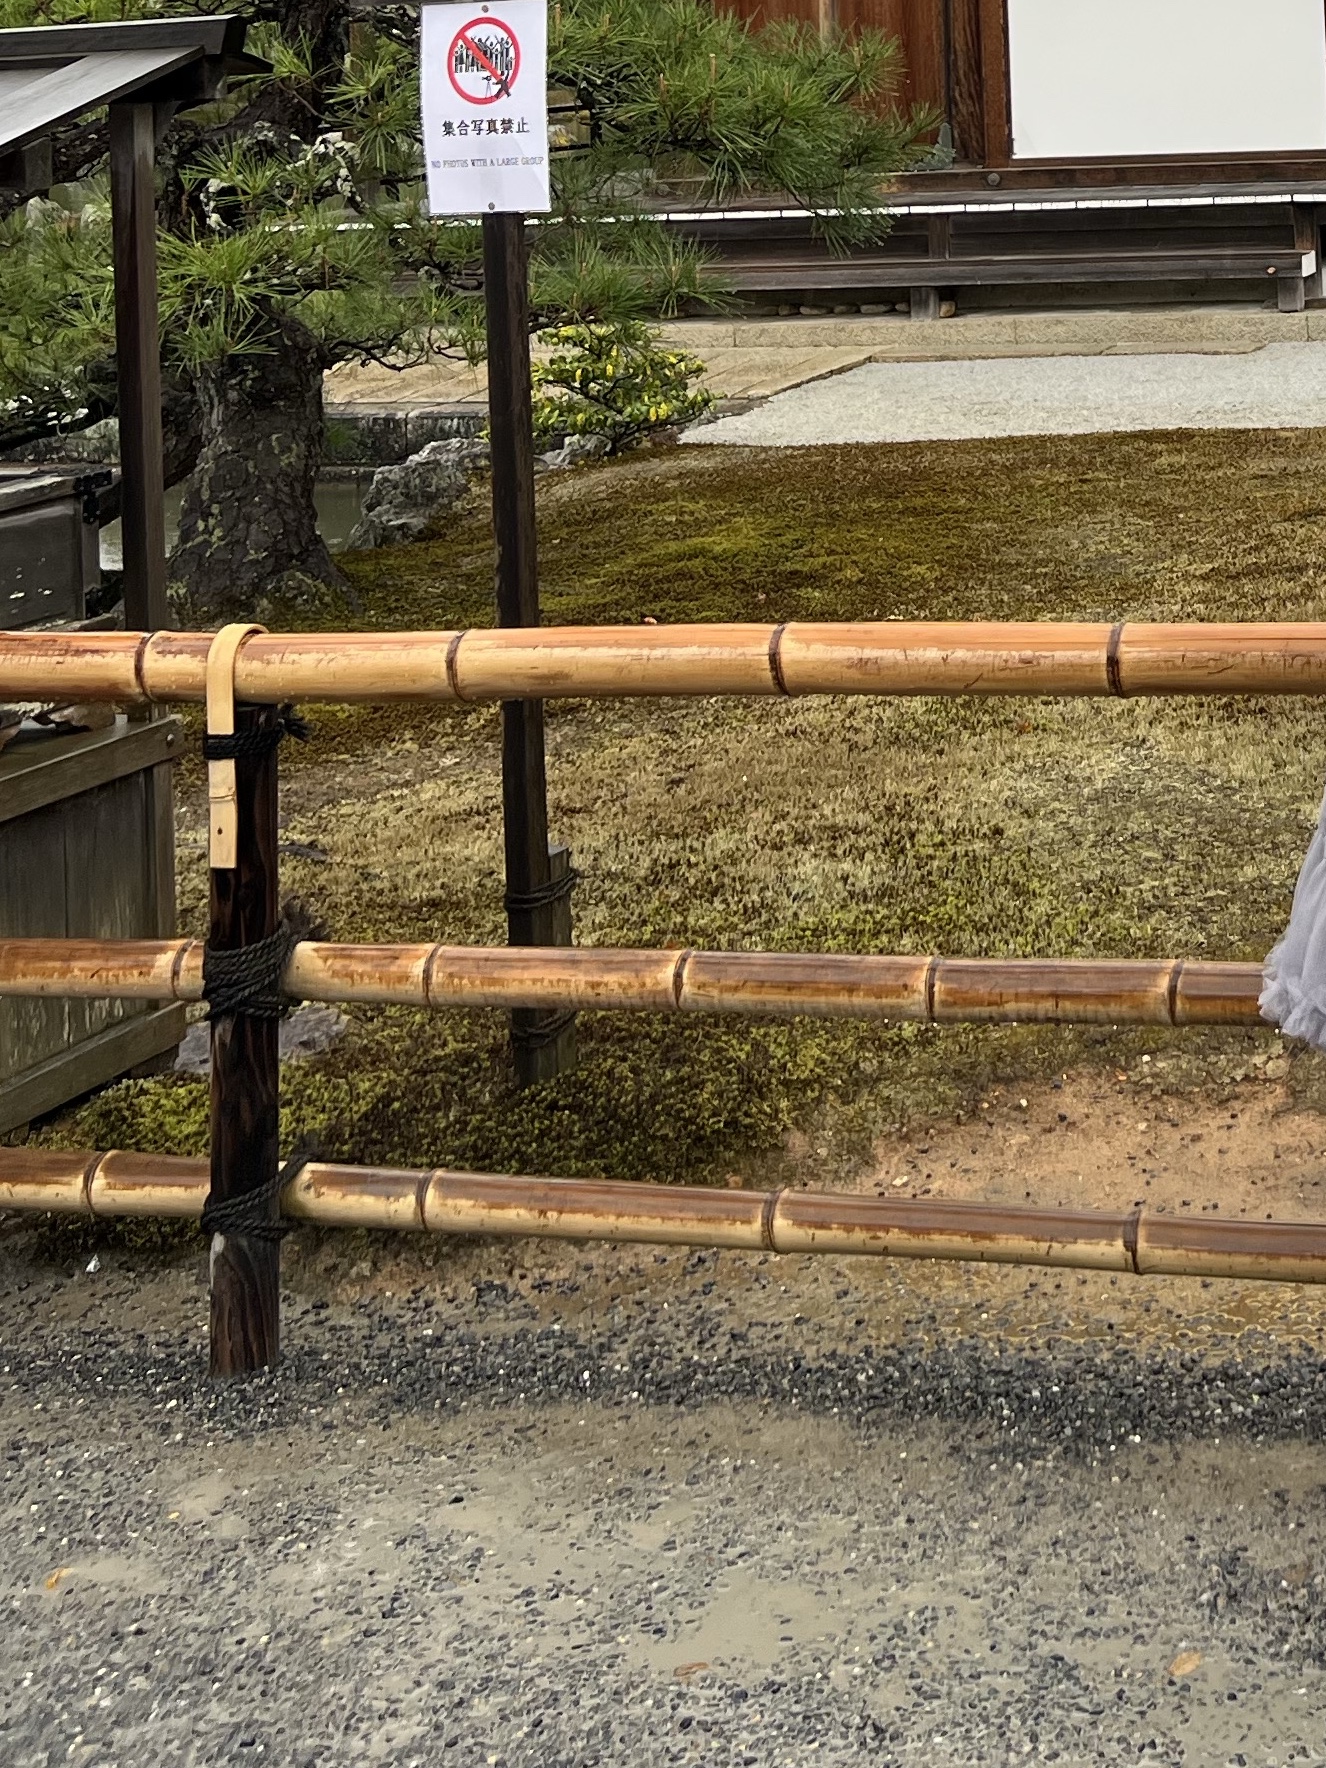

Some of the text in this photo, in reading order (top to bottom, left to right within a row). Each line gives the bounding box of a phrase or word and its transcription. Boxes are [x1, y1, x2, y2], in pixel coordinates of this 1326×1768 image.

[442, 116, 530, 137] 集合写真禁止
